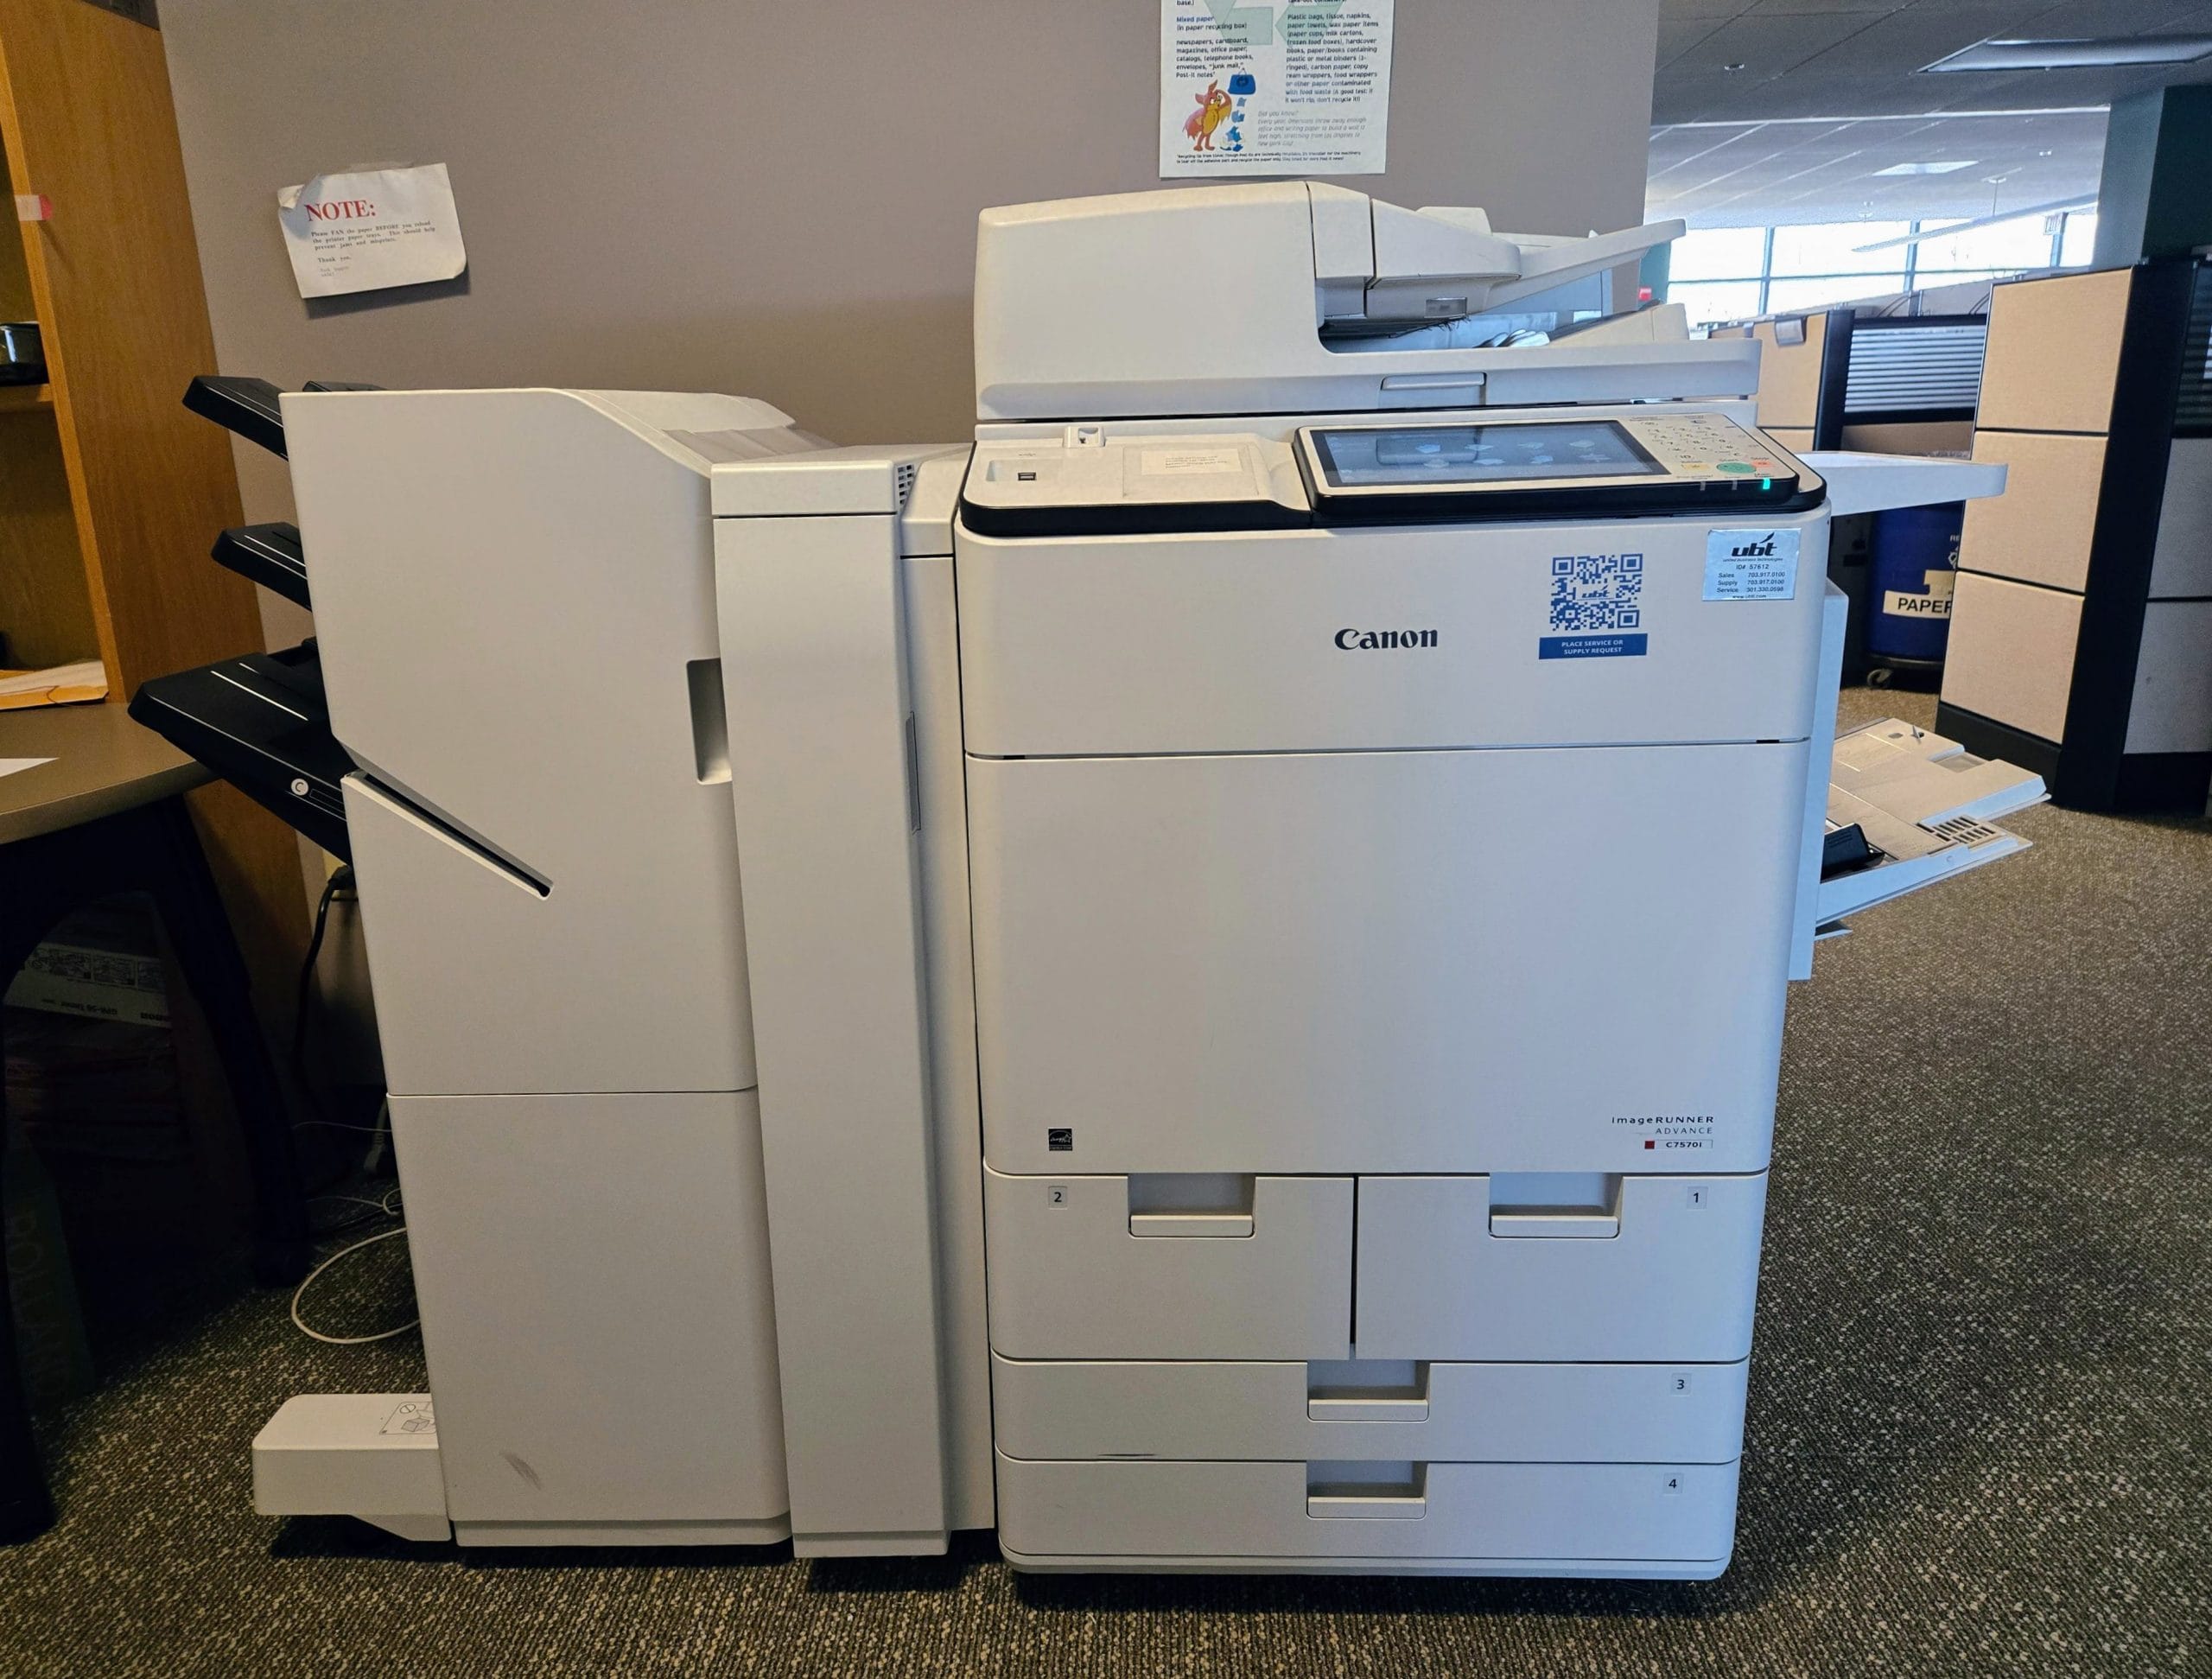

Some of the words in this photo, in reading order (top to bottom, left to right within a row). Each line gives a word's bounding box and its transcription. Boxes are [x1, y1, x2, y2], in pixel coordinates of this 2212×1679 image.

[305, 200, 376, 222] NOTE:
[1732, 532, 1777, 556] ubt
[1334, 628, 1438, 650] Canon
[296, 782, 304, 792] C
[1611, 1116, 1713, 1125] imageRUNNER
[1054, 1192, 1062, 1202] 2
[1694, 1192, 1699, 1203] 1
[1676, 1379, 1685, 1390] 3
[1669, 1479, 1677, 1488] 4
